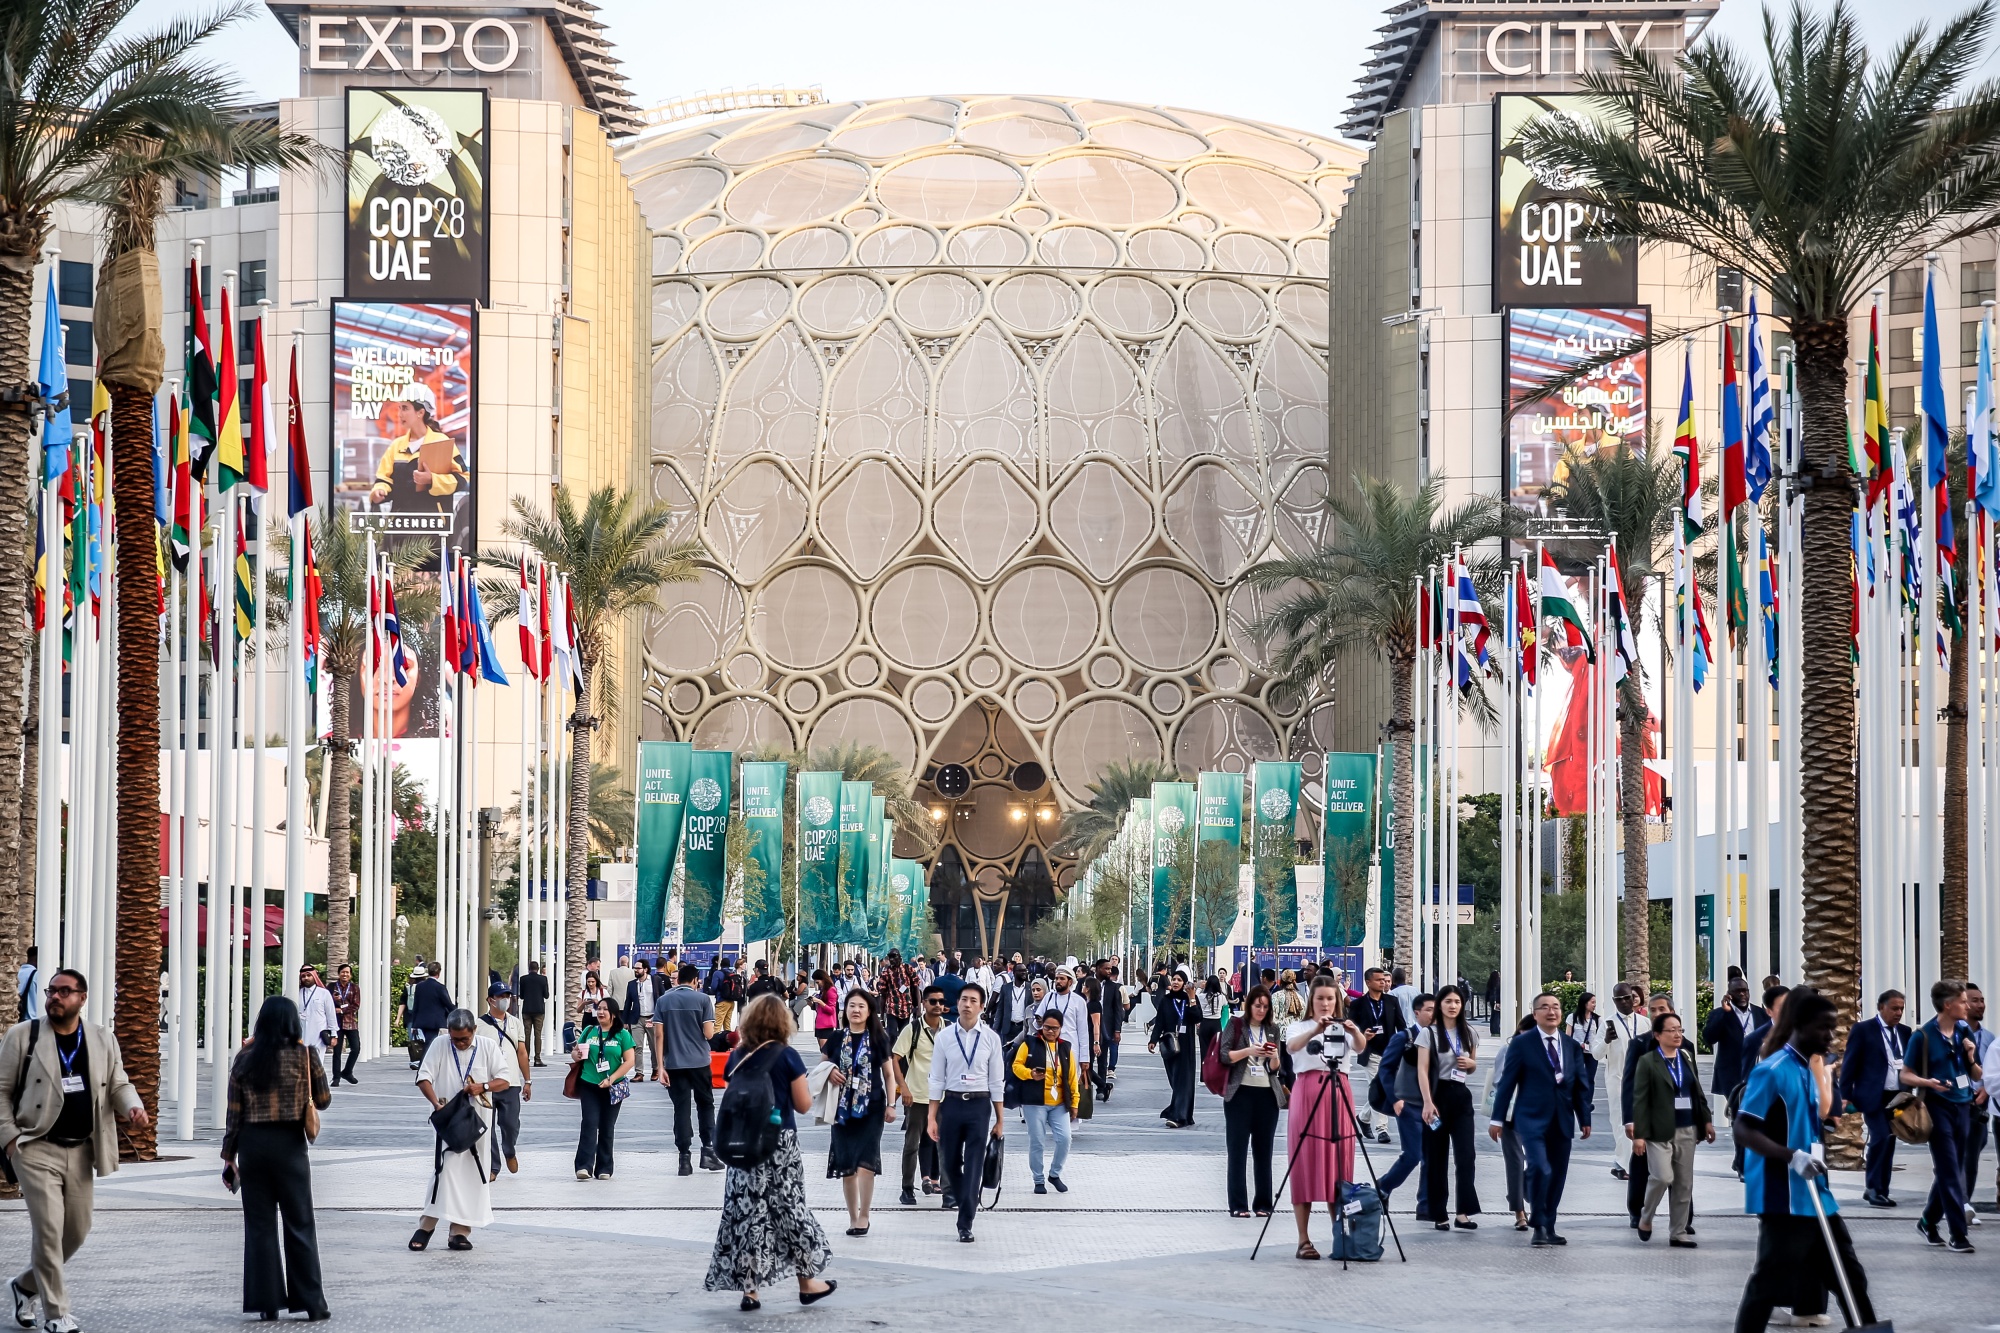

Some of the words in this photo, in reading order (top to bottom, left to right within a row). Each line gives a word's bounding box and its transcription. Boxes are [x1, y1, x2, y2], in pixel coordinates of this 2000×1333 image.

[310, 16, 519, 72] EXPO
[1486, 21, 1653, 75] CITY
[369, 197, 465, 238] COP28
[369, 239, 431, 280] UAE
[1520, 245, 1582, 285] UAE
[351, 347, 431, 366] WELCOME
[433, 347, 454, 366] TO
[351, 366, 415, 384] GENDER
[1606, 357, 1634, 385] في
[351, 383, 428, 402] EQUALITY
[1563, 385, 1634, 409] المساواة
[351, 401, 383, 420] DAY
[1531, 412, 1602, 435] الجنسين
[379, 518, 444, 529] DECEMBER
[645, 768, 674, 780] UNITE.
[644, 780, 664, 791] ACT.
[746, 786, 771, 796] UNITE.
[1331, 779, 1358, 789] UNITE.
[644, 792, 683, 804] DELIVER.
[746, 797, 762, 807] ACT.
[1204, 796, 1229, 806] UNITE.
[1330, 790, 1348, 800] ACT.
[840, 804, 858, 813] NITE.
[1203, 807, 1220, 816] ACT.
[1330, 801, 1366, 812] DELIVER.
[688, 815, 726, 834] COP28
[840, 813, 850, 822] CT.
[1203, 816, 1236, 827] DELIVER.
[688, 834, 714, 851] UAE
[804, 829, 838, 846] COP28
[804, 845, 826, 862] UAE
